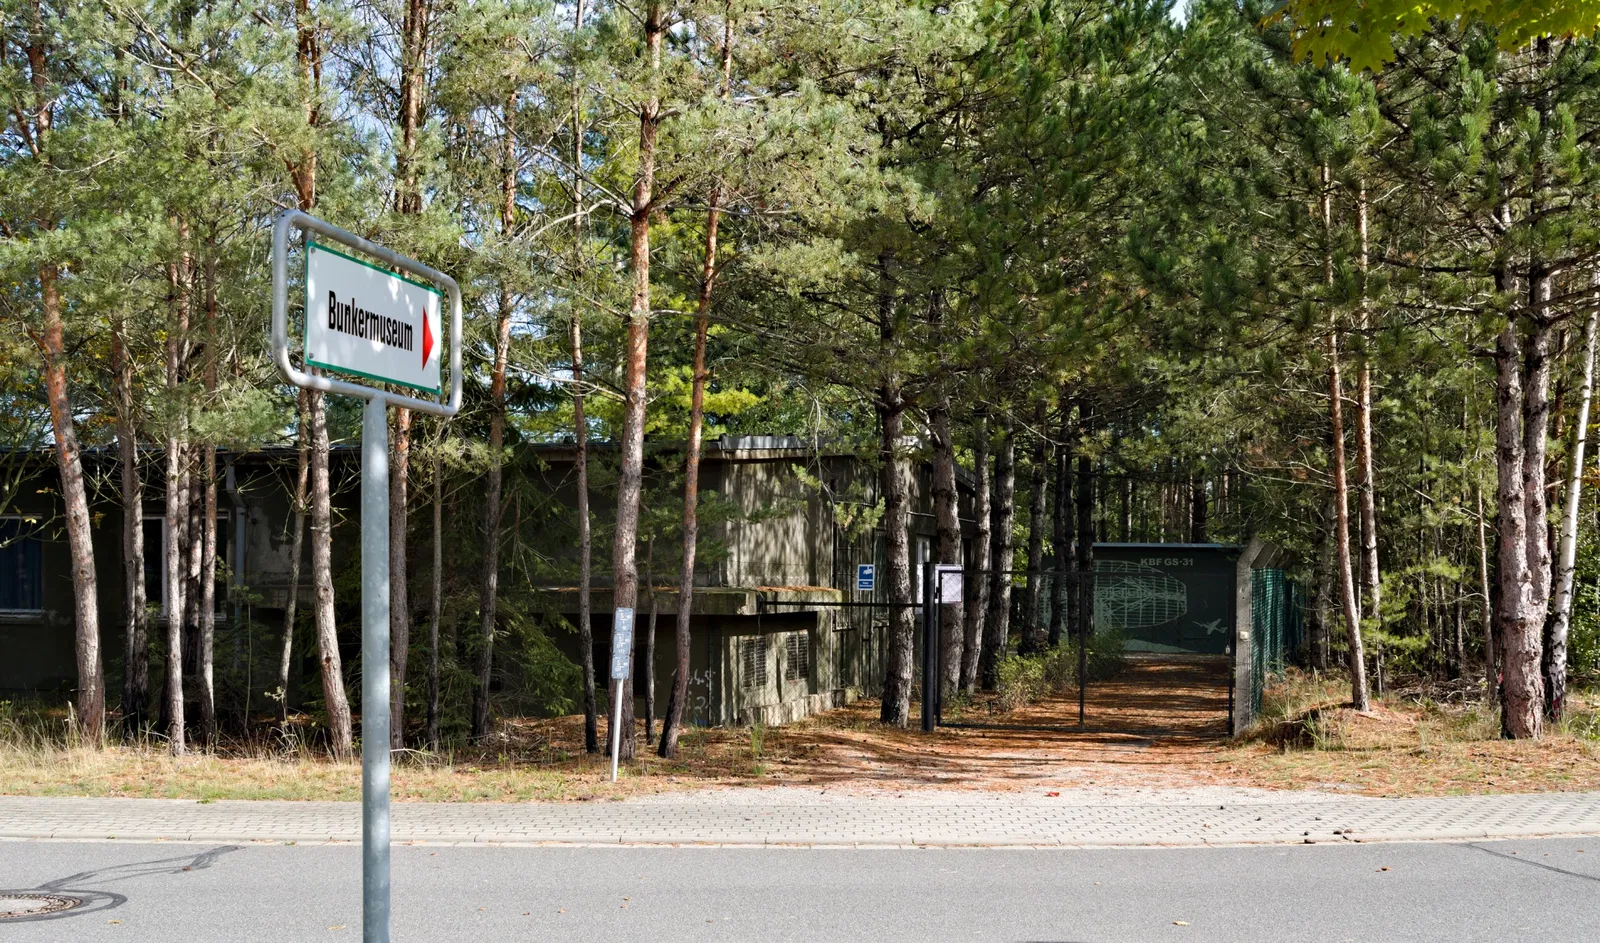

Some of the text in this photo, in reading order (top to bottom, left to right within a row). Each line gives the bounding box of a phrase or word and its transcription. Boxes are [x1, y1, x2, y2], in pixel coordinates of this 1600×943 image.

[328, 290, 413, 352] Bunkermuseum
[1140, 558, 1194, 566] KBF GS-31
